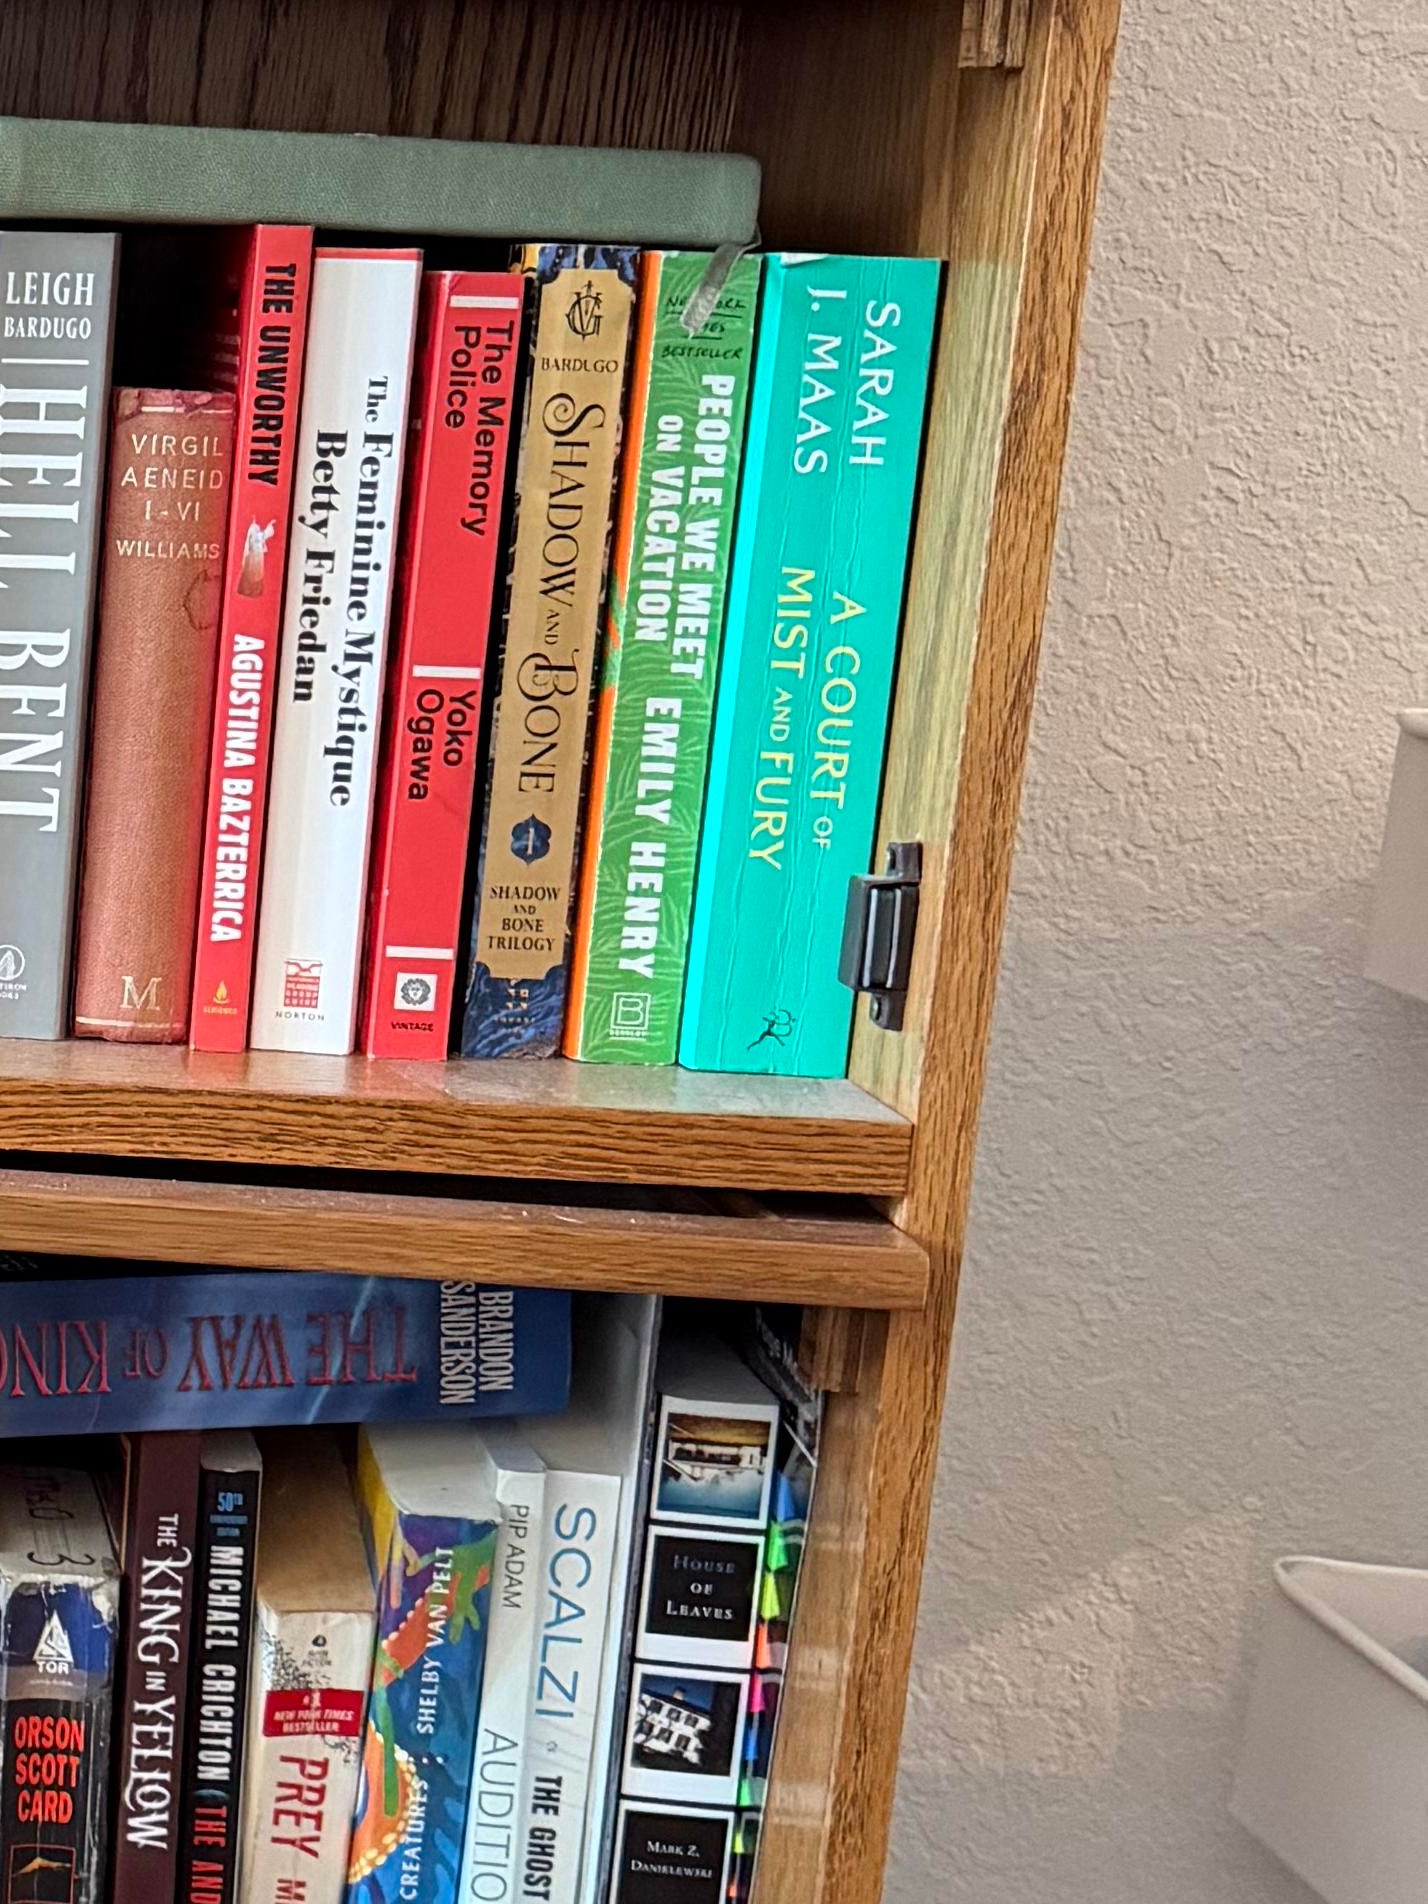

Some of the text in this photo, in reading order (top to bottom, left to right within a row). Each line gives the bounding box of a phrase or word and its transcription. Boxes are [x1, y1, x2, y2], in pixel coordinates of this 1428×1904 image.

[7, 272, 93, 305] LEIGH
[4, 317, 91, 341] BARDUGO
[445, 324, 481, 429] Police
[461, 320, 514, 538] The Memory
[124, 1348, 168, 1377] OF
[179, 1315, 294, 1391] WAY
[307, 1313, 420, 1383] THE
[269, 1755, 329, 1861] PREY
